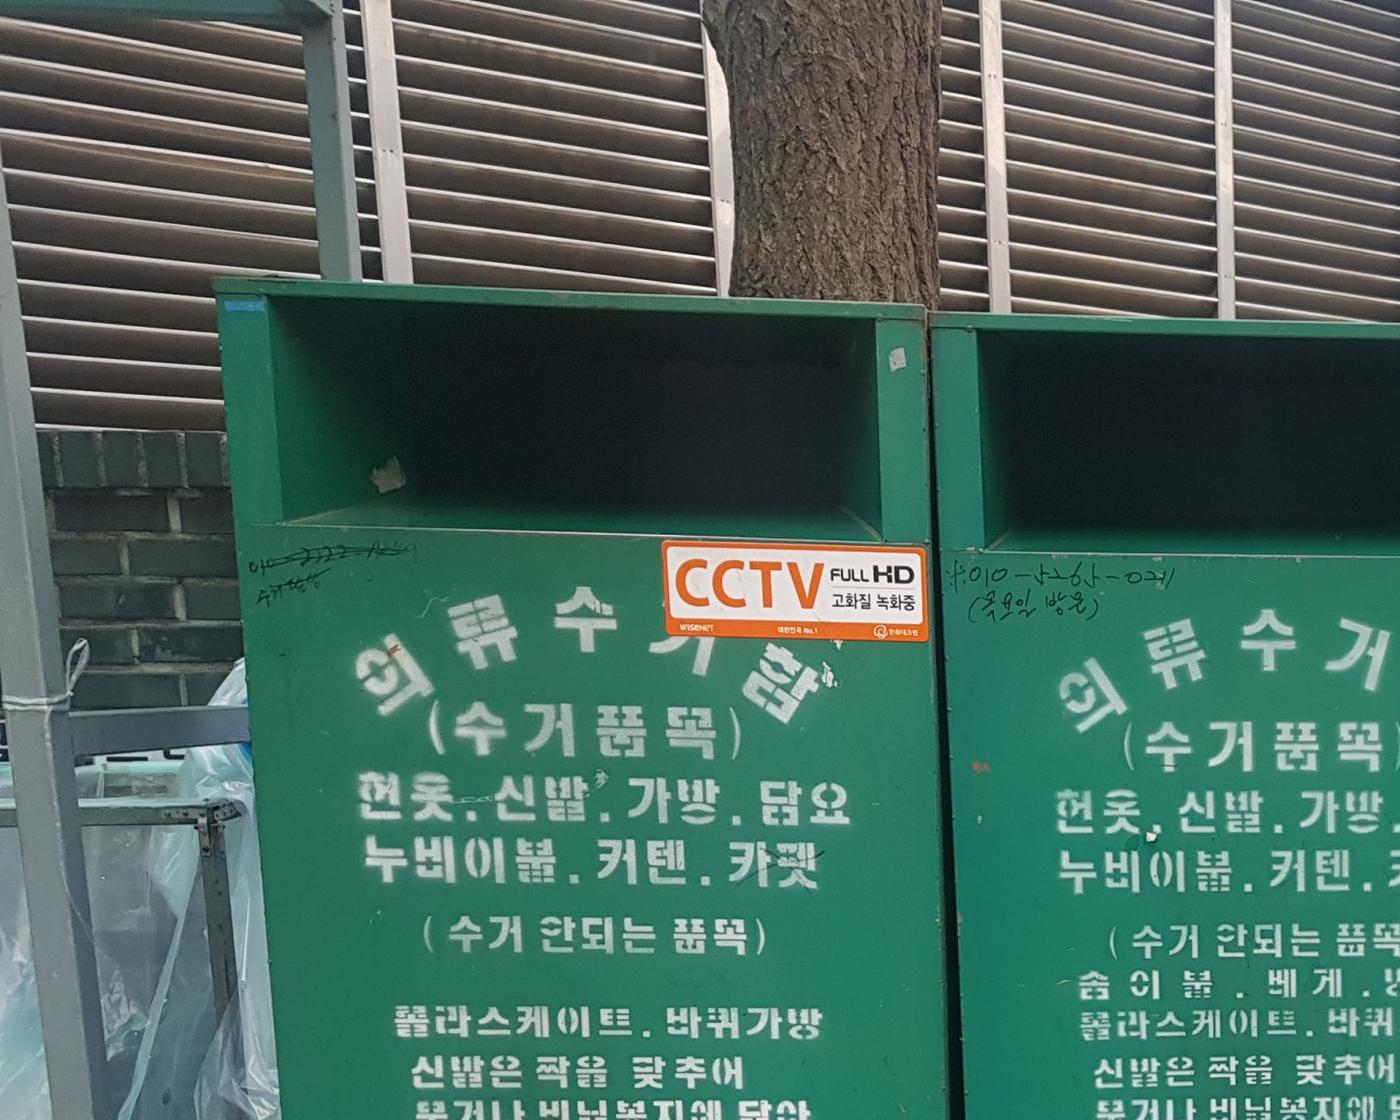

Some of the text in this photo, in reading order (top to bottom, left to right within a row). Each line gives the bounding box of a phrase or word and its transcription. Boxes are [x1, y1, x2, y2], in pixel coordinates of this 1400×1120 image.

[675, 559, 915, 609] CCTV FULL HD
[832, 593, 916, 611] 고화질 녹화중
[760, 781, 850, 826] 담요
[541, 917, 656, 953] 안되는
[1218, 924, 1320, 957] 안되는
[667, 1007, 823, 1040] 바퀴가방
[411, 1056, 743, 1089] 신발은 짝을 맞추어
[1095, 1054, 1394, 1089] 신발은 짝을 맞추어
